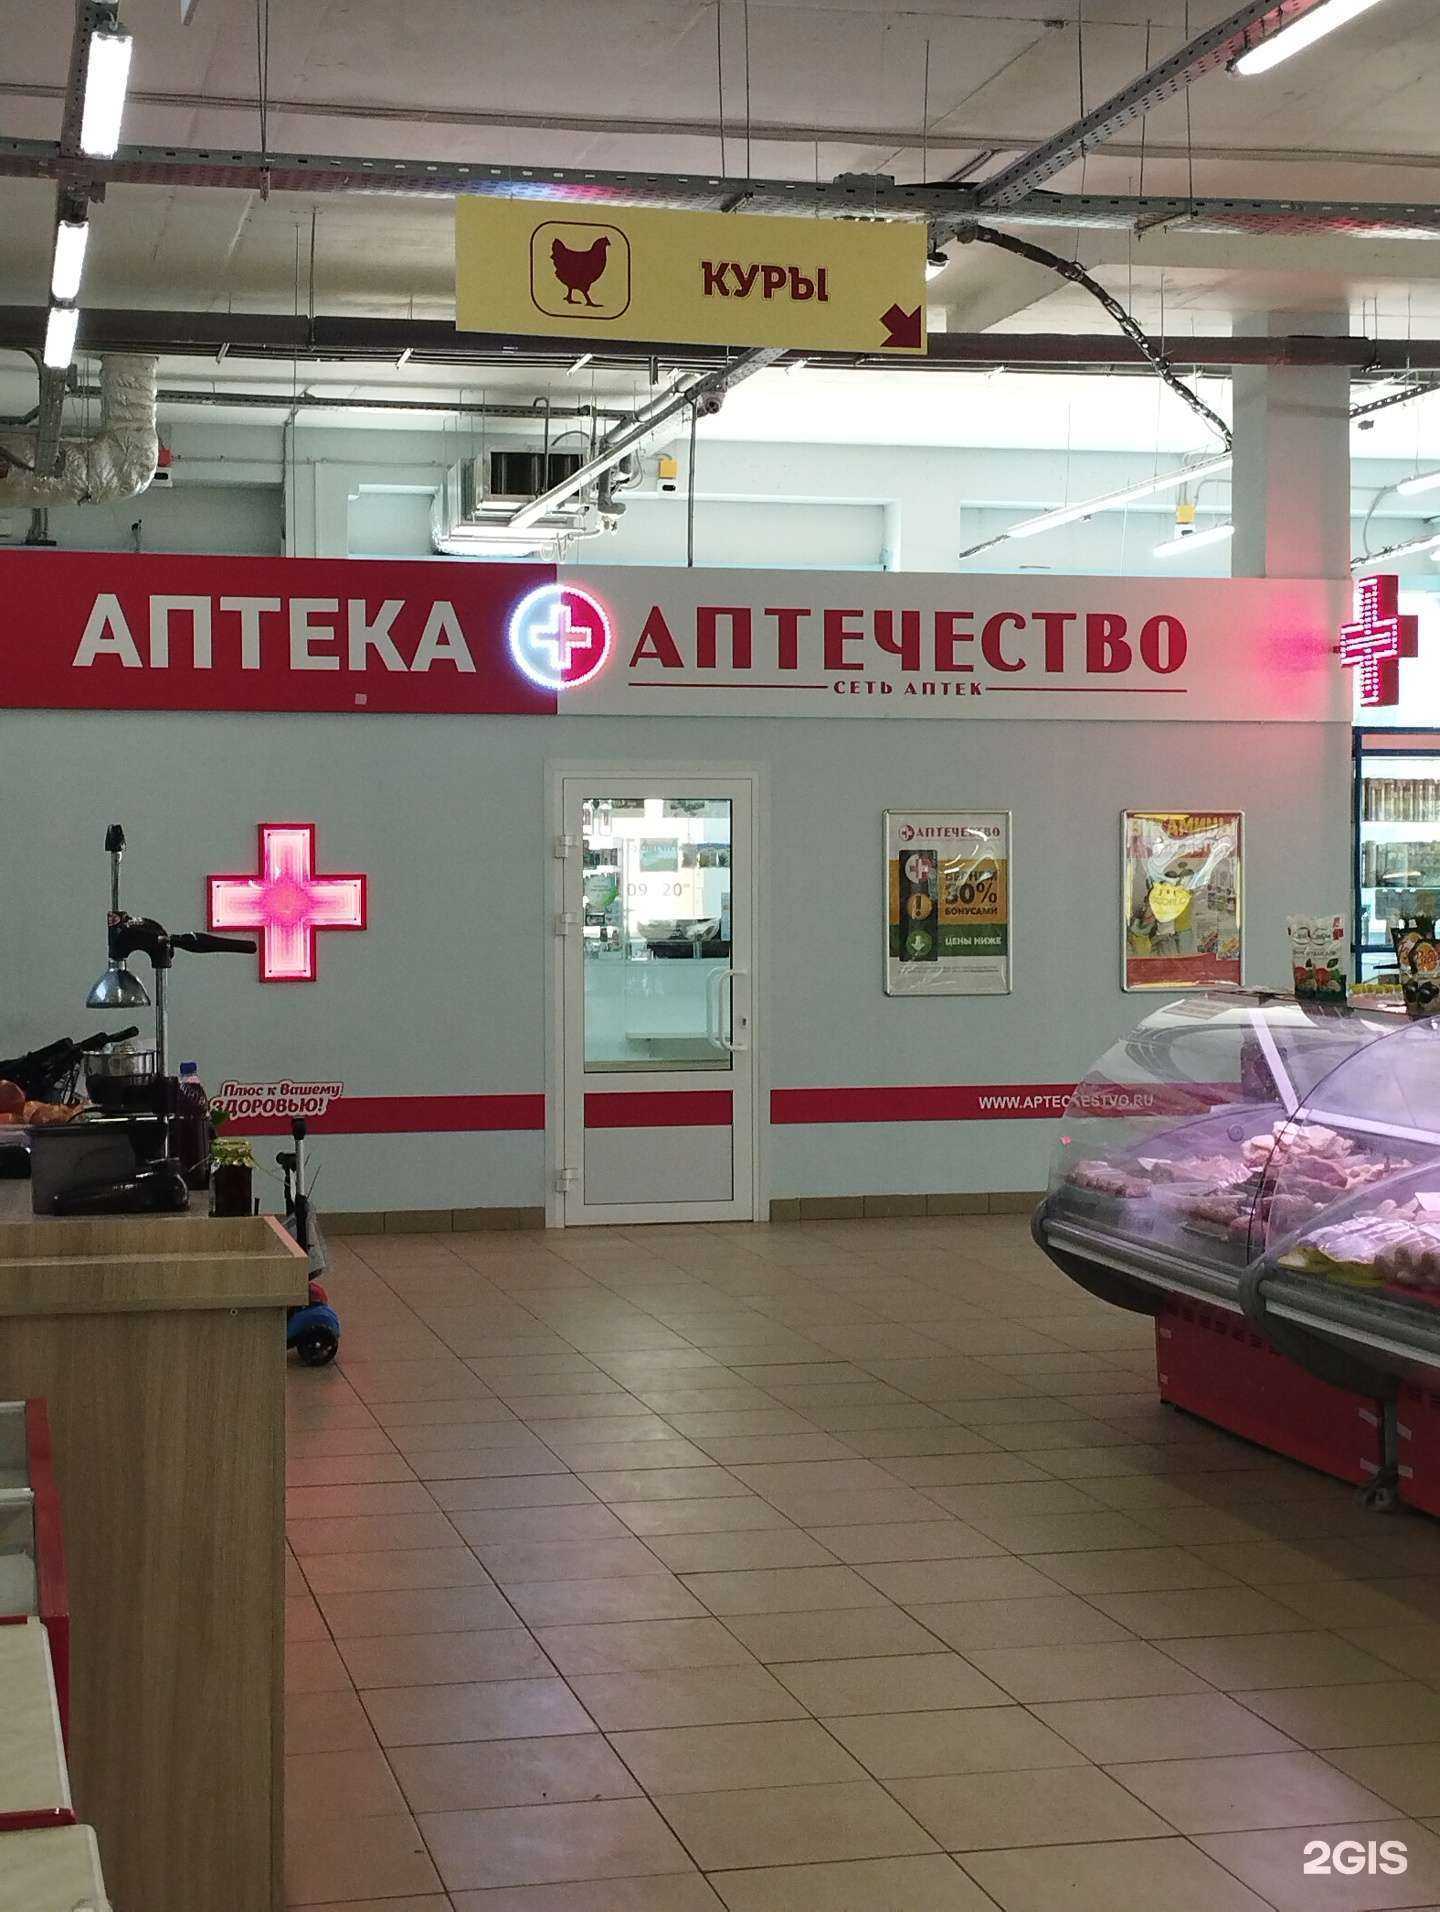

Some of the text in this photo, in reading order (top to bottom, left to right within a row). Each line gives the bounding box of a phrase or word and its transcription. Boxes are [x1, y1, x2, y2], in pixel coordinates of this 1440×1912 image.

[700, 260, 829, 302] КУРЫ
[72, 593, 477, 673] АПТЕКА
[629, 605, 1188, 675] АПТЕЧЕСТВО
[833, 680, 982, 696] СЕТЬ АПТЕК
[945, 906, 998, 916] БОНУСАМИ
[945, 936, 1002, 947] ЦЕНЫ НИЖЕ
[223, 1083, 343, 1097] Плюс к Вашему
[211, 1098, 324, 1116] ЗДОРОВЬЮ!
